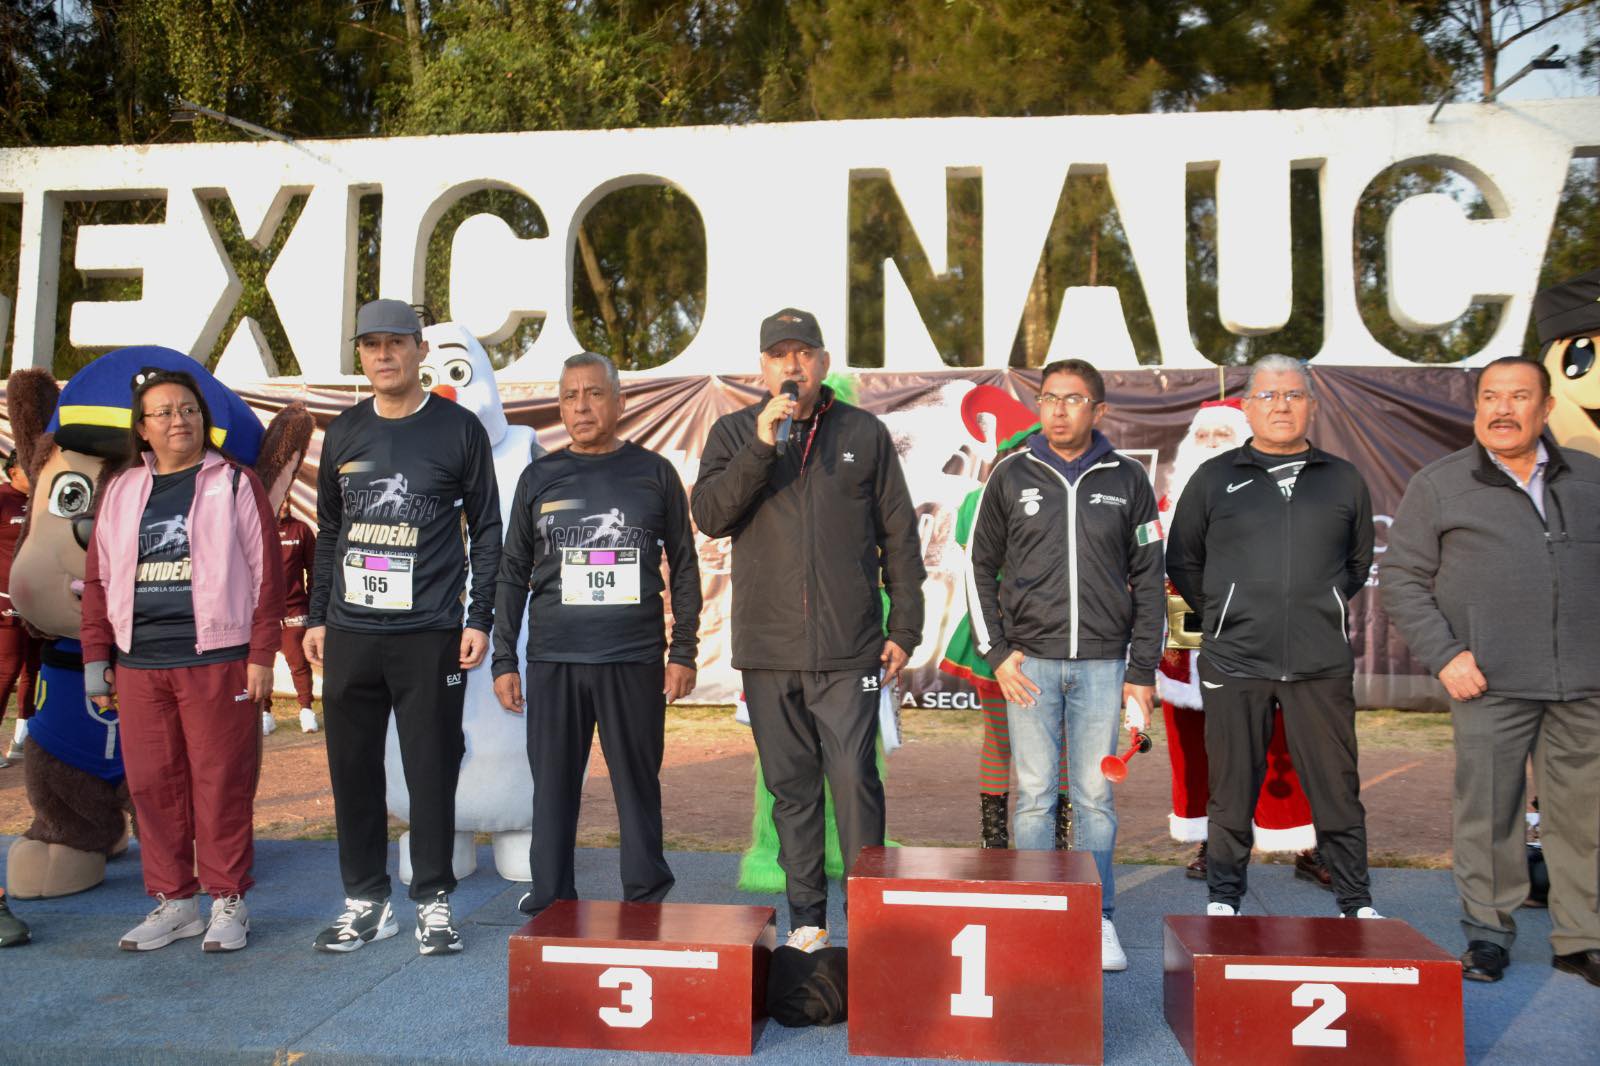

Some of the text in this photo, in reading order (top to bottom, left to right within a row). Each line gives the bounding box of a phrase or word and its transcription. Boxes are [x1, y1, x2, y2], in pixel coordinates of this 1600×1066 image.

[0, 173, 707, 372] EXICO
[347, 522, 420, 547] NAVIDEÑA
[136, 557, 193, 582] AVIDEÑ
[586, 571, 616, 589] 164
[362, 575, 388, 594] 165
[446, 672, 462, 684] EA7
[950, 924, 994, 1019] 1
[598, 967, 653, 1028] 3
[1291, 982, 1348, 1048] 2
